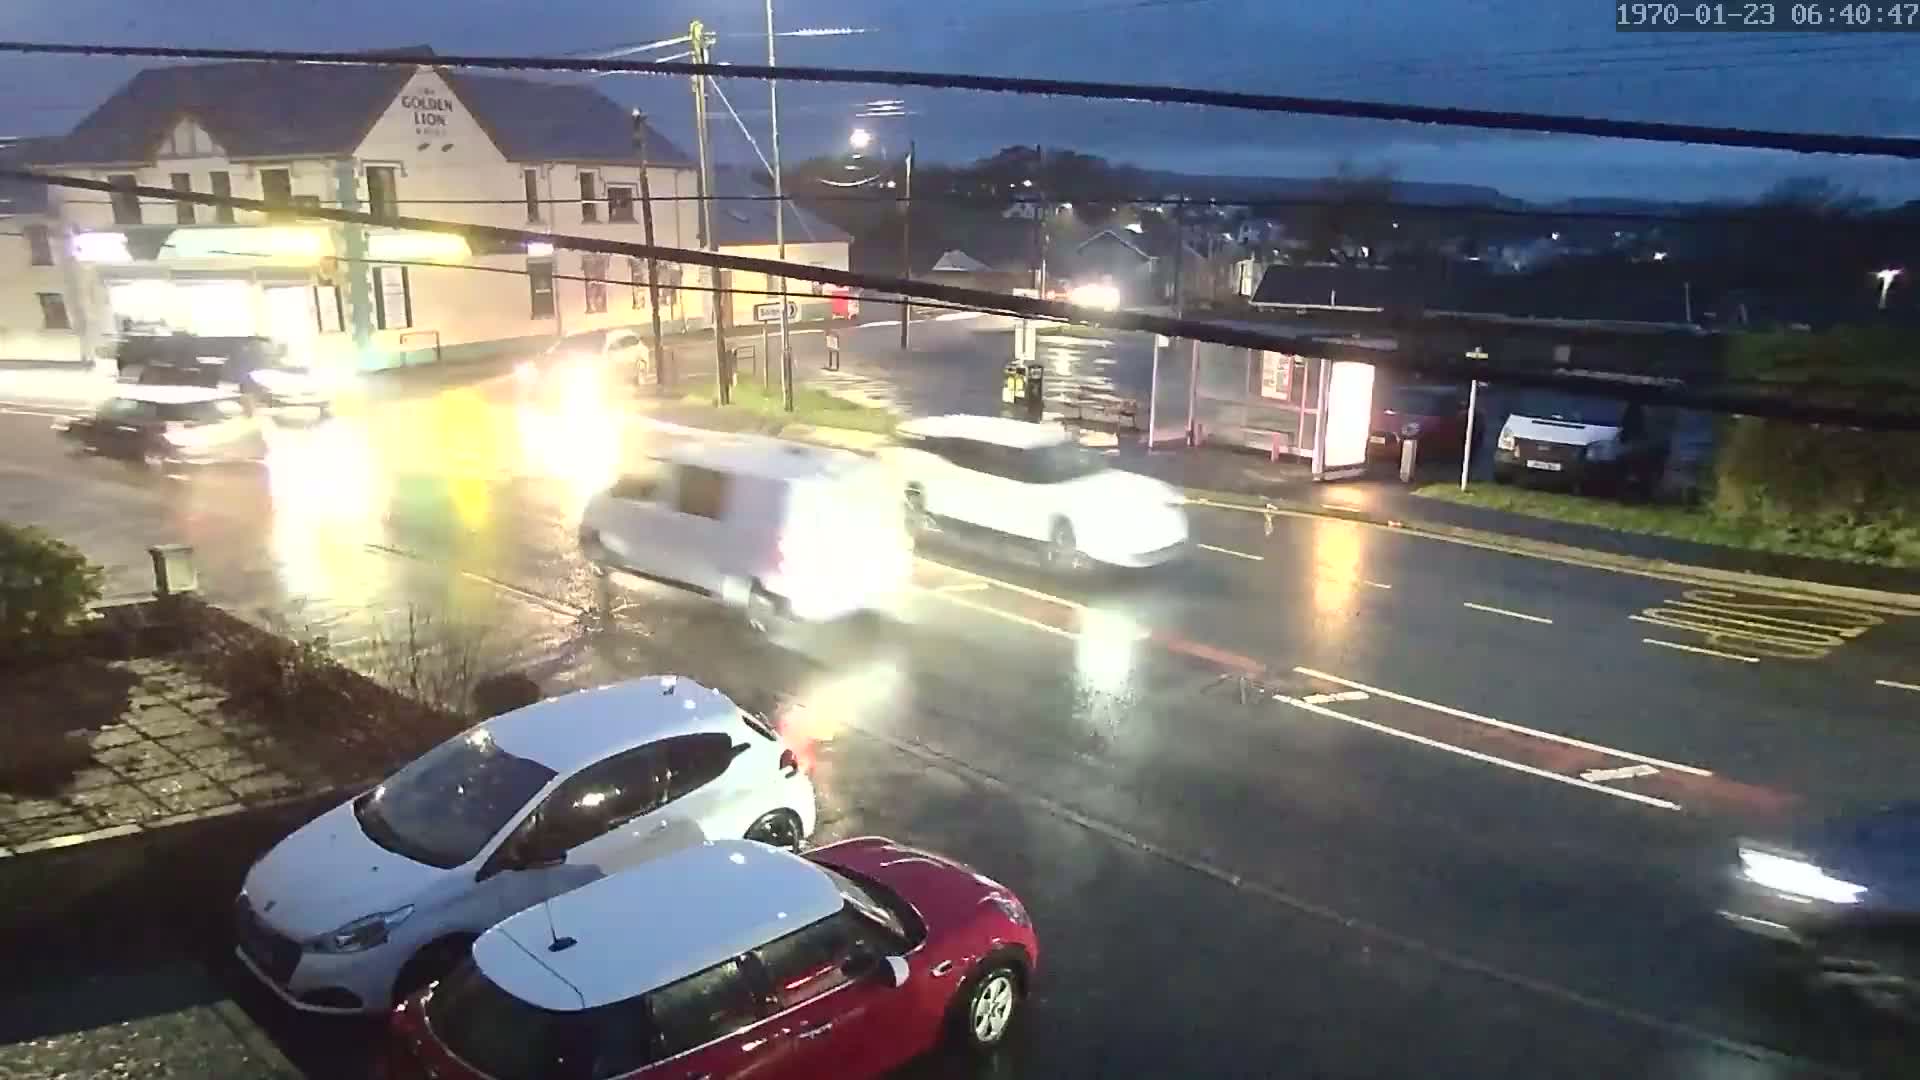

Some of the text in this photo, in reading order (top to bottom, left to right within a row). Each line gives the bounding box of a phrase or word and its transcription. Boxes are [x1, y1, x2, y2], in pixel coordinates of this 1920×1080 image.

[401, 95, 453, 112] GOLDEN
[414, 111, 446, 127] LION
[1628, 590, 1885, 659] STOP
